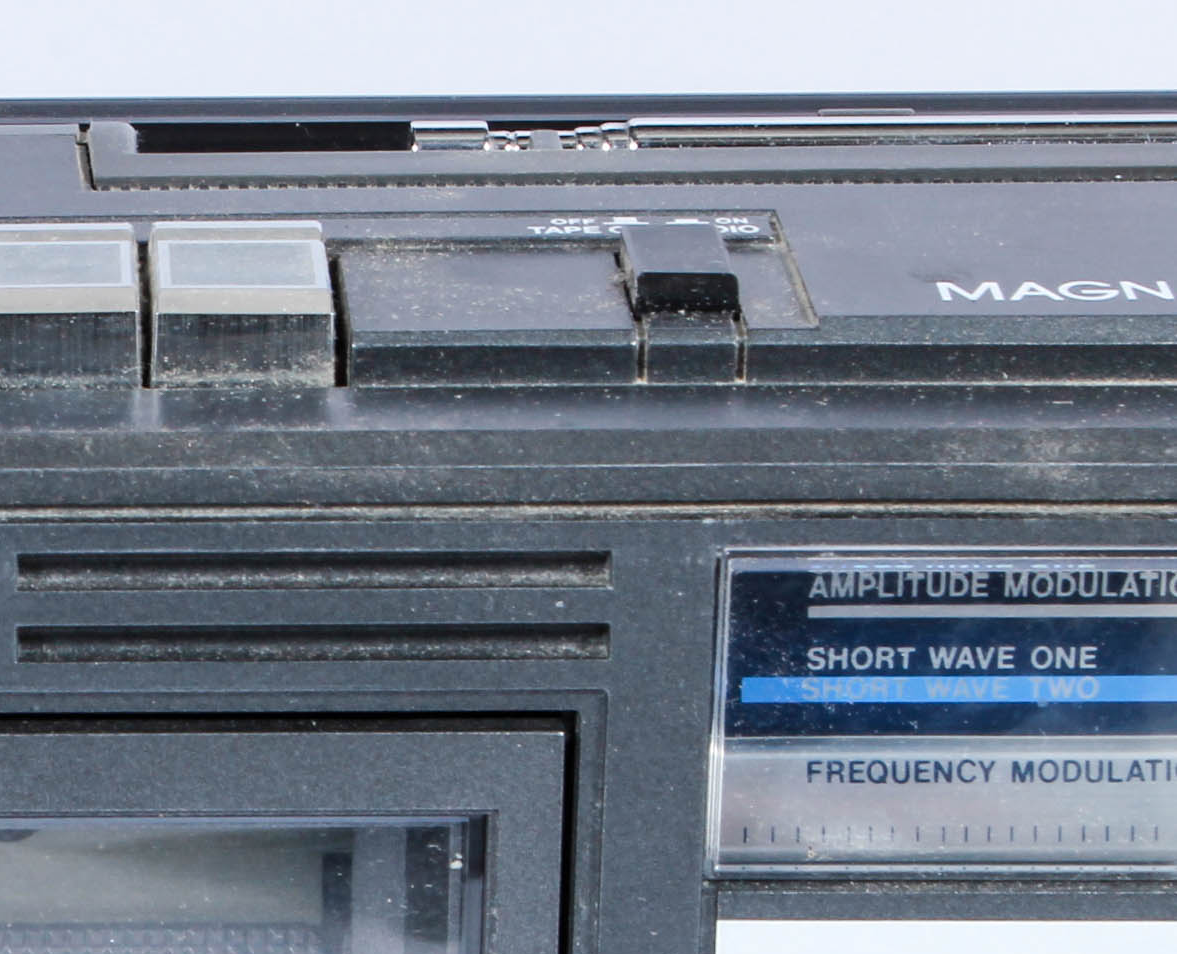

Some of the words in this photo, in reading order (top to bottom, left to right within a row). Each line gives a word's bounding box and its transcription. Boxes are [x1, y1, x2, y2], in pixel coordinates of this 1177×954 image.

[526, 225, 602, 235] TAPE
[549, 217, 596, 226] OFF
[714, 217, 750, 225] ON
[935, 280, 1175, 301] MAGN
[807, 570, 990, 599] AMPLITUDE
[806, 646, 916, 671] SHORT
[928, 646, 1016, 670] WAVE
[1030, 645, 1098, 670] ONE
[801, 677, 911, 700] SHORT
[925, 676, 1009, 699] WAVE
[1029, 676, 1100, 700] TWO
[806, 759, 997, 784] FREQUENCY
[1010, 758, 1177, 784] MODULATI
